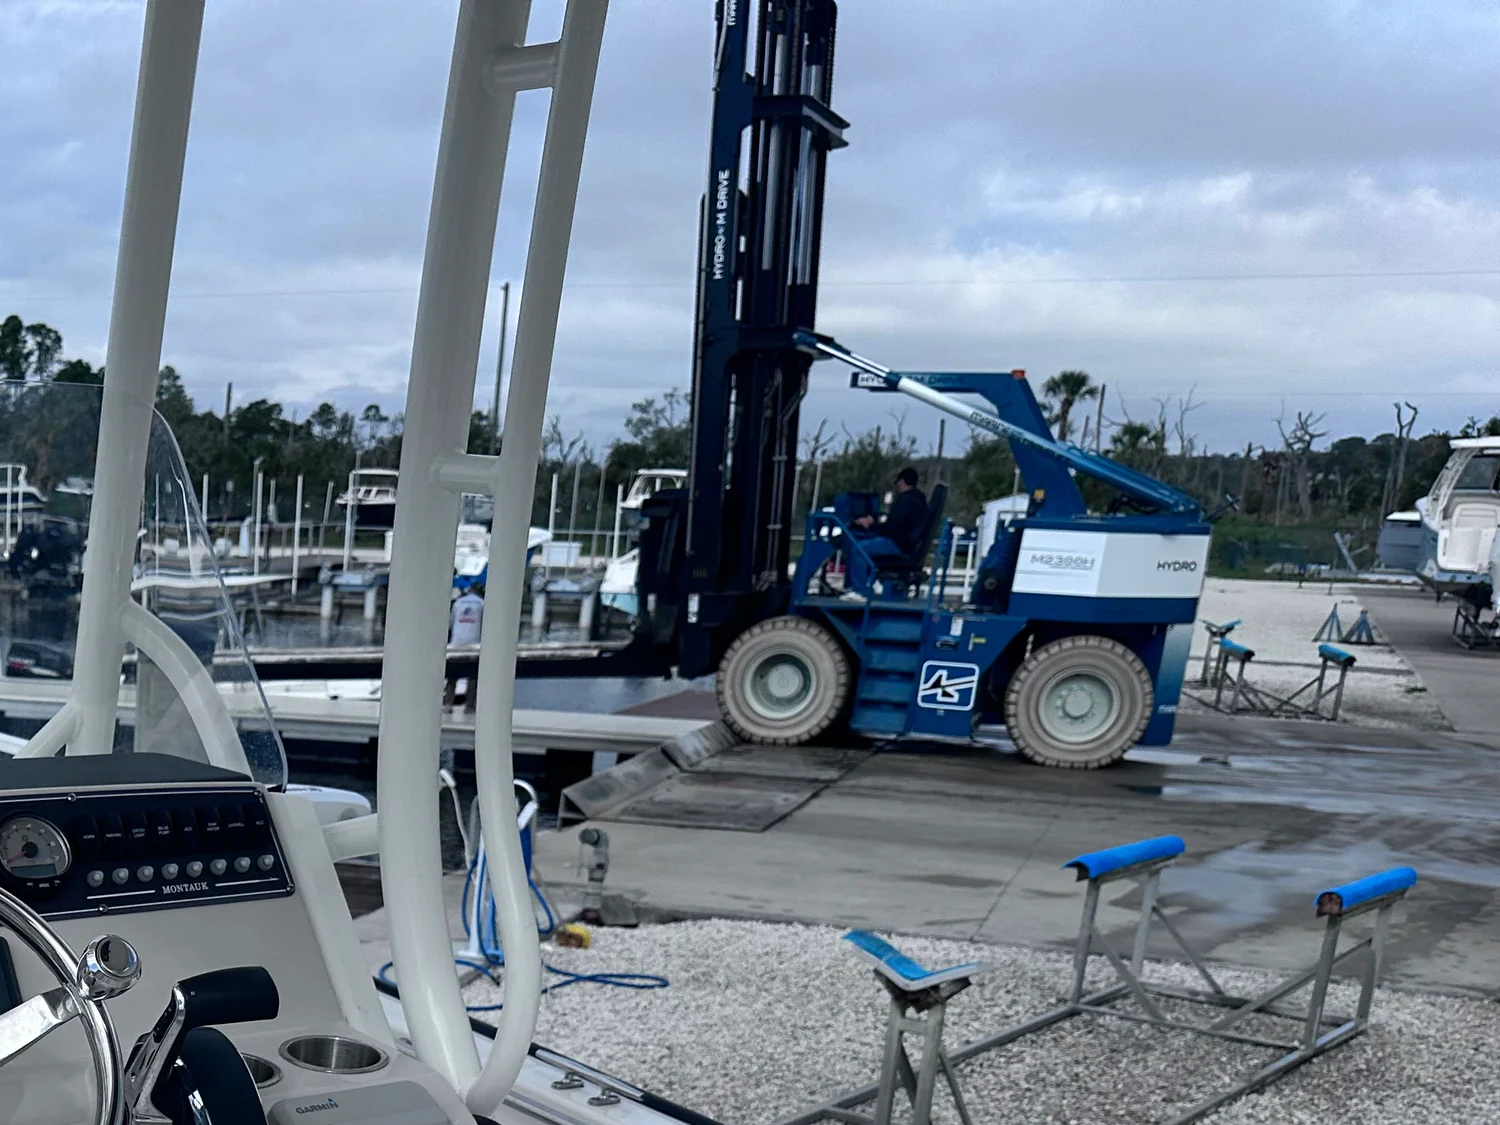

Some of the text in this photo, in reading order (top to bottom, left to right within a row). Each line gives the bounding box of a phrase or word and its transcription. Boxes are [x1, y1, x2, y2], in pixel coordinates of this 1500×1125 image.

[717, 169, 730, 208] DRIVE
[712, 235, 726, 280] HYDRO
[1156, 560, 1198, 572] HYDRO
[162, 882, 209, 894] MONTAUK
[295, 1101, 339, 1115] GARMIN
